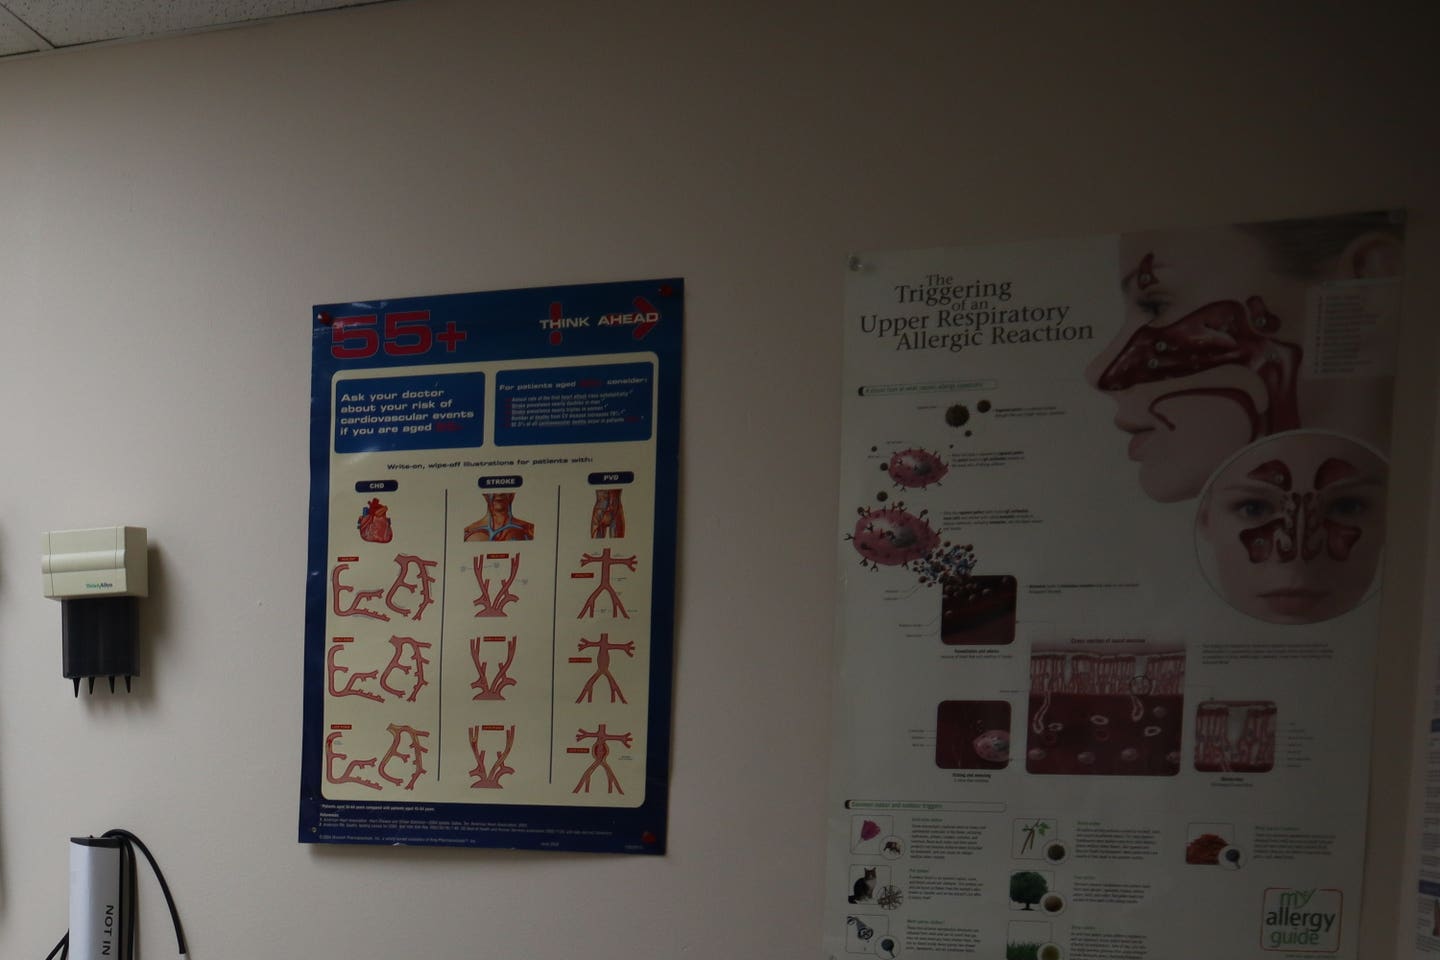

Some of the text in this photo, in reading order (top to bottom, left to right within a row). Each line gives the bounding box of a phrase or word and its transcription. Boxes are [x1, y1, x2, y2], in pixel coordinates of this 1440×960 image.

[926, 273, 954, 286] The
[895, 279, 1013, 305] Triggering
[951, 300, 989, 312] of an
[539, 311, 659, 330] THINK AHEAD
[861, 305, 1071, 338] Upper Respiratory
[331, 310, 467, 359] 55+
[896, 323, 1095, 352] Allergic Reaction
[499, 384, 515, 392] For
[516, 382, 553, 392] patients
[555, 381, 577, 390] aged
[341, 390, 445, 403] Ask your doctor
[340, 399, 454, 414] about your risk of
[340, 410, 475, 425] cardiovascular events
[340, 427, 350, 436] if
[352, 427, 375, 437] you
[377, 425, 399, 433] are
[402, 423, 433, 435] aged
[387, 463, 426, 471] Write-on,
[428, 460, 461, 470] wipe-off
[463, 459, 515, 468] illustrations
[516, 458, 530, 466] for
[532, 457, 569, 467] patients
[485, 478, 516, 486] STROKE
[603, 474, 620, 482] PVD
[369, 482, 385, 490] CHD
[1280, 889, 1318, 909] my
[103, 905, 114, 937] NOT
[1266, 906, 1337, 933] allergy
[1271, 928, 1320, 949] guide
[101, 941, 111, 956] IN
